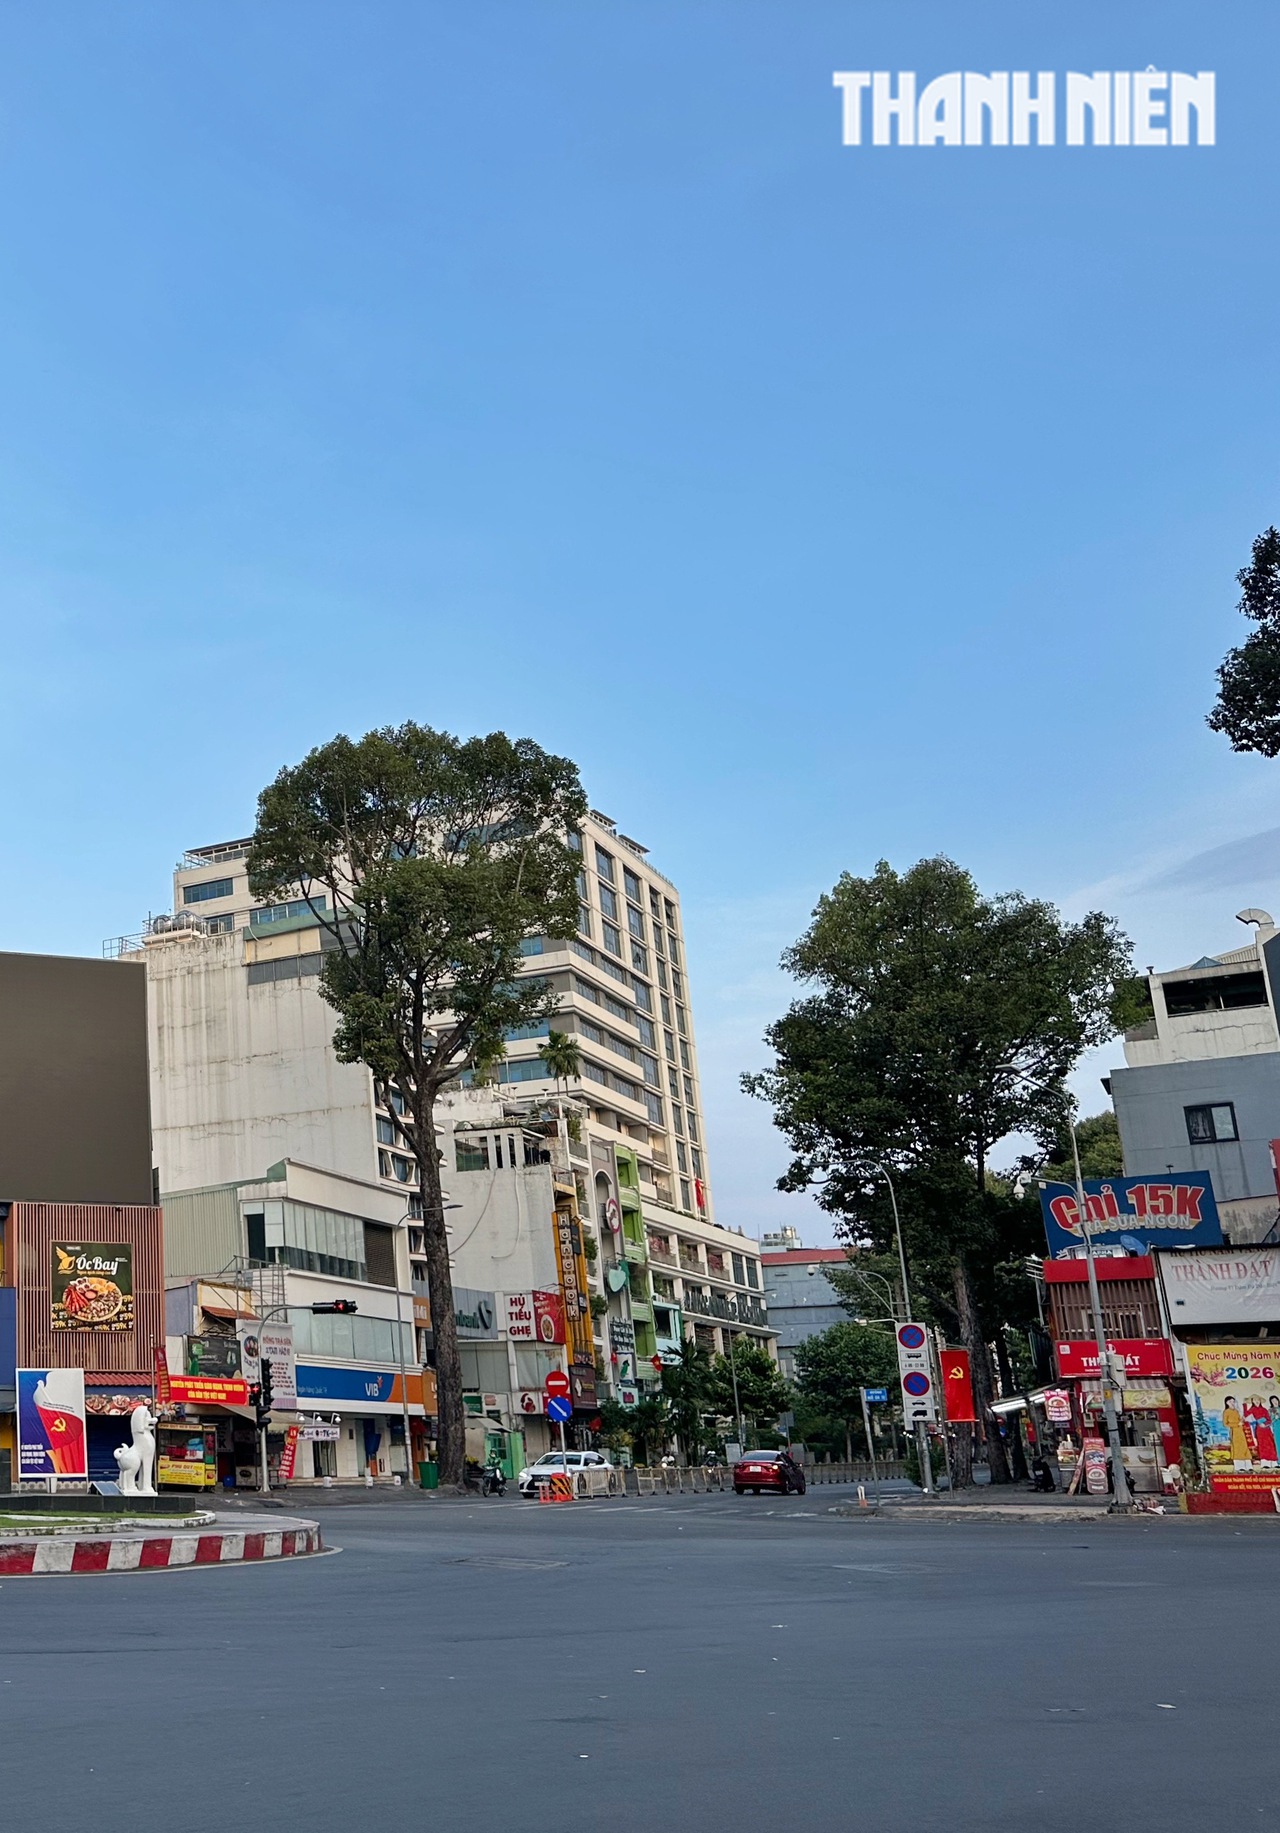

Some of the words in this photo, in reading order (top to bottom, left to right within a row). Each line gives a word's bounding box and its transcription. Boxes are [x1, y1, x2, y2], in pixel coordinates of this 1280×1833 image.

[1050, 1184, 1119, 1230] Chỉ
[1126, 1184, 1205, 1221] 15K
[1143, 1213, 1190, 1228] NGON
[92, 1257, 119, 1275] Bay
[1172, 1259, 1232, 1281] THÀNH
[508, 1307, 531, 1321] TIẾU
[509, 1326, 531, 1337] GHẸ
[1197, 1351, 1220, 1360] Chúc
[1223, 1350, 1247, 1361] Mừng
[1250, 1350, 1271, 1359] Năm
[1225, 1367, 1274, 1379] 2026
[365, 1383, 379, 1396] VIB
